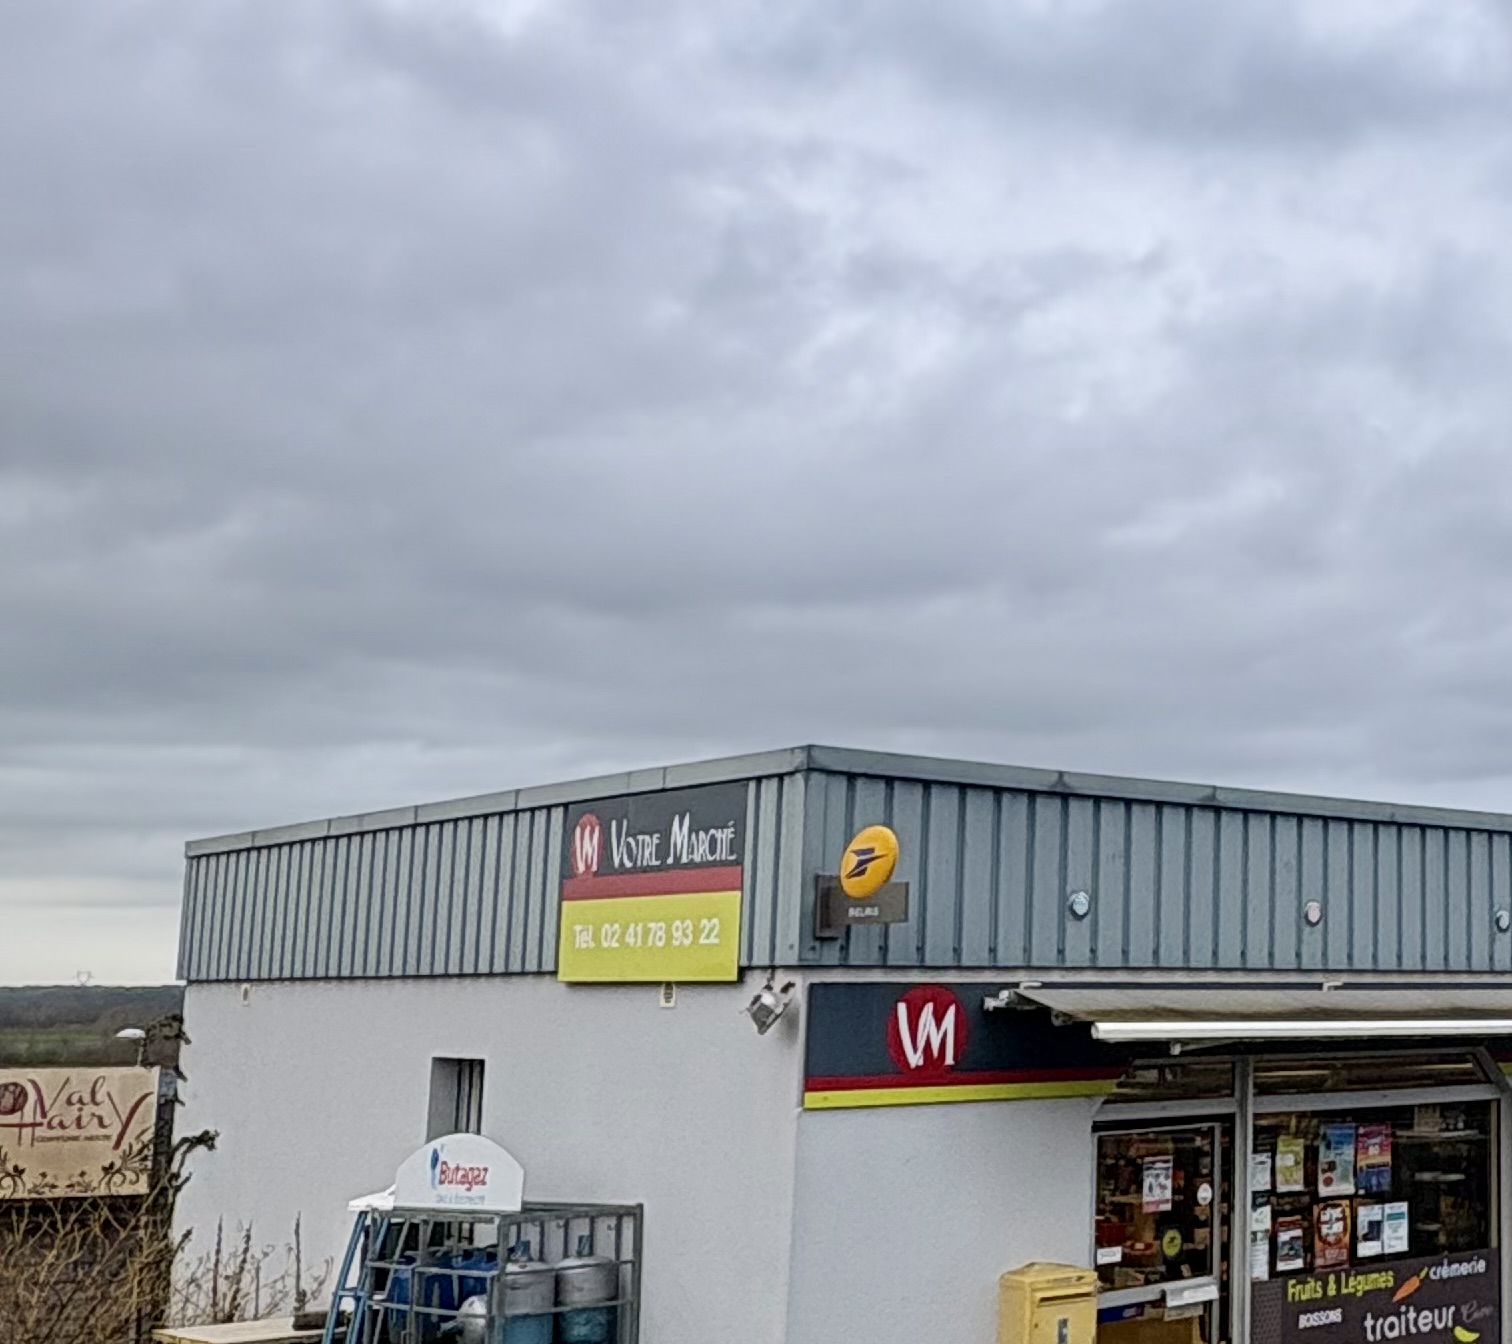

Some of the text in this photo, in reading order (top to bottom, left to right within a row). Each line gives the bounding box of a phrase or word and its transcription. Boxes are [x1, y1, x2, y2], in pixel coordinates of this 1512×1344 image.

[610, 817, 662, 869] VOTRE
[600, 922, 621, 949] 02
[625, 922, 643, 948] 41
[647, 921, 666, 948] 78
[671, 919, 694, 947] 93
[699, 917, 721, 945] 22
[438, 1160, 489, 1192] Butagaz
[1287, 1269, 1395, 1303] Fruits & Légumes
[1363, 1304, 1456, 1342] traiteur
